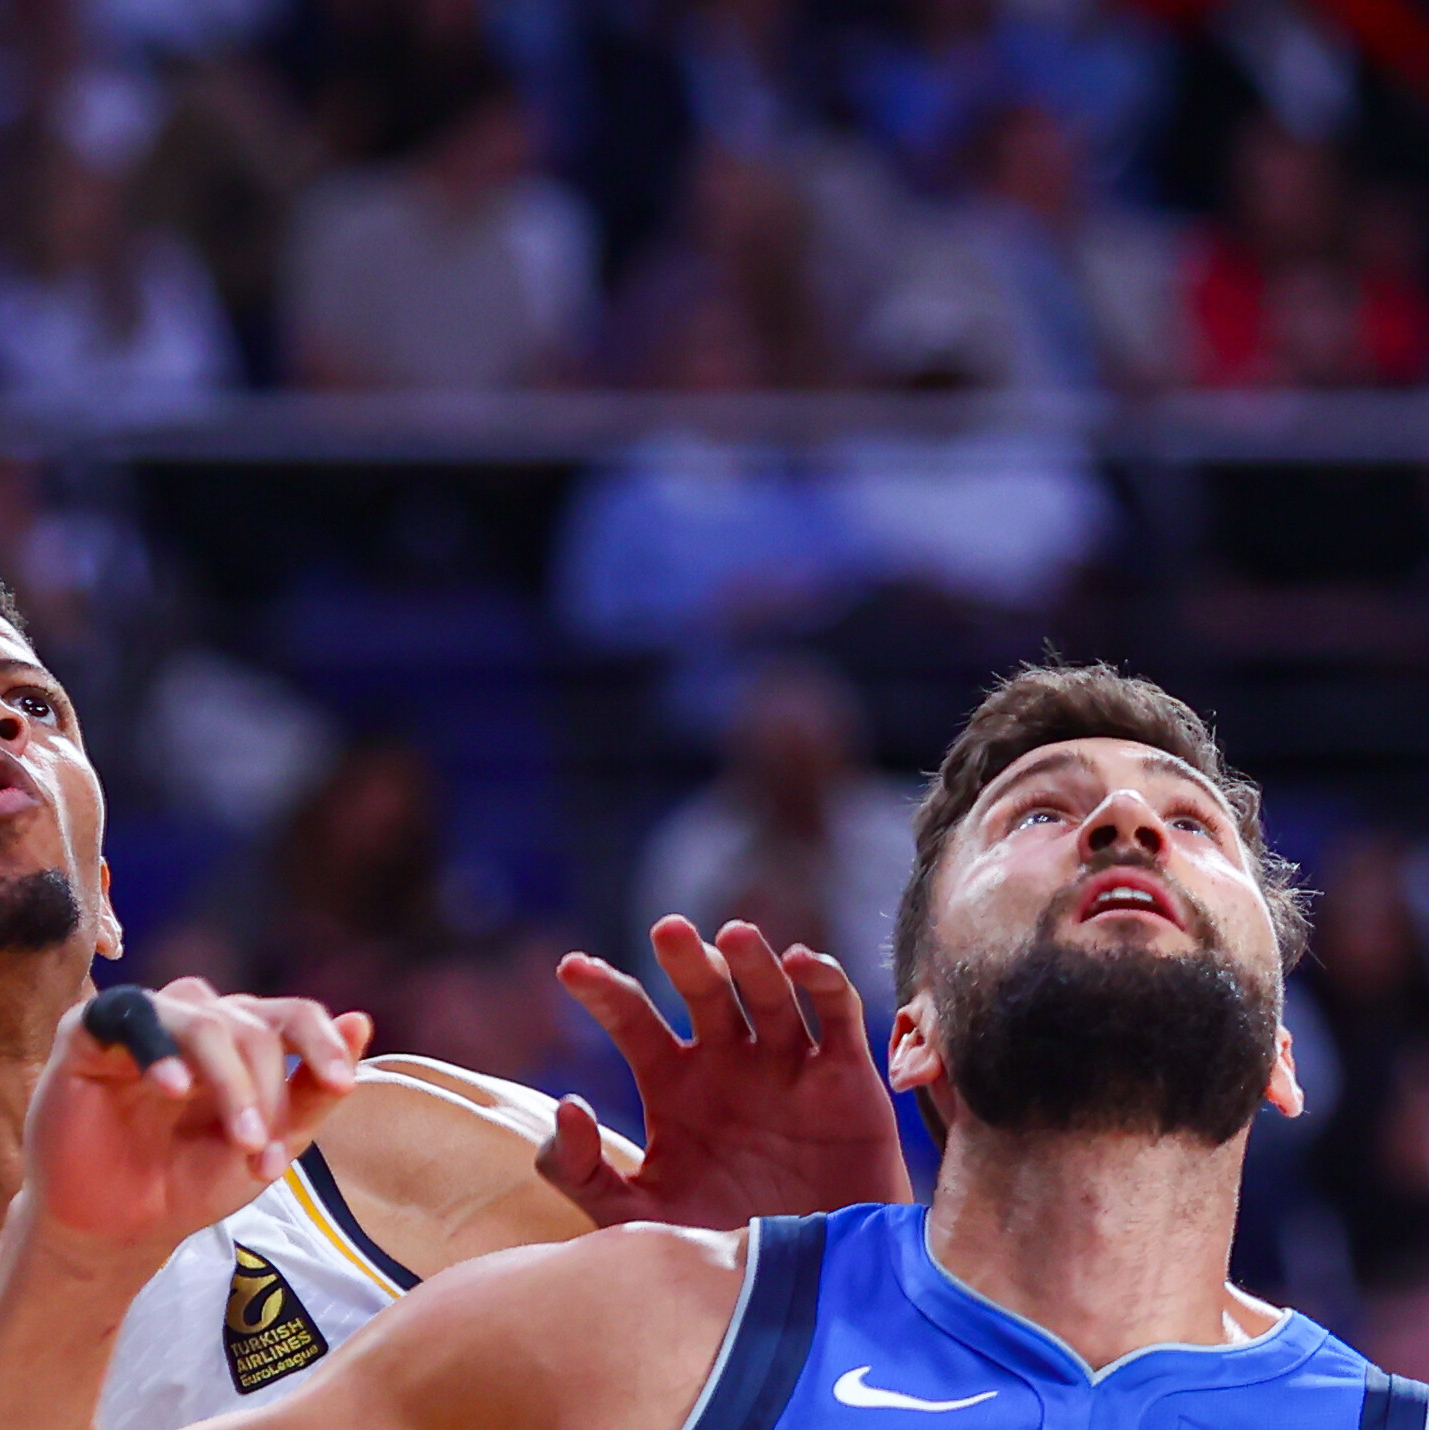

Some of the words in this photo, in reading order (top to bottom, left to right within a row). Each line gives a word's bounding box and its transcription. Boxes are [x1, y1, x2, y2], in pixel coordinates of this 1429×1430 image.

[230, 1317, 304, 1357] TURKISH
[237, 1330, 312, 1373] AIRLINES
[240, 1344, 318, 1387] EuroLeague
